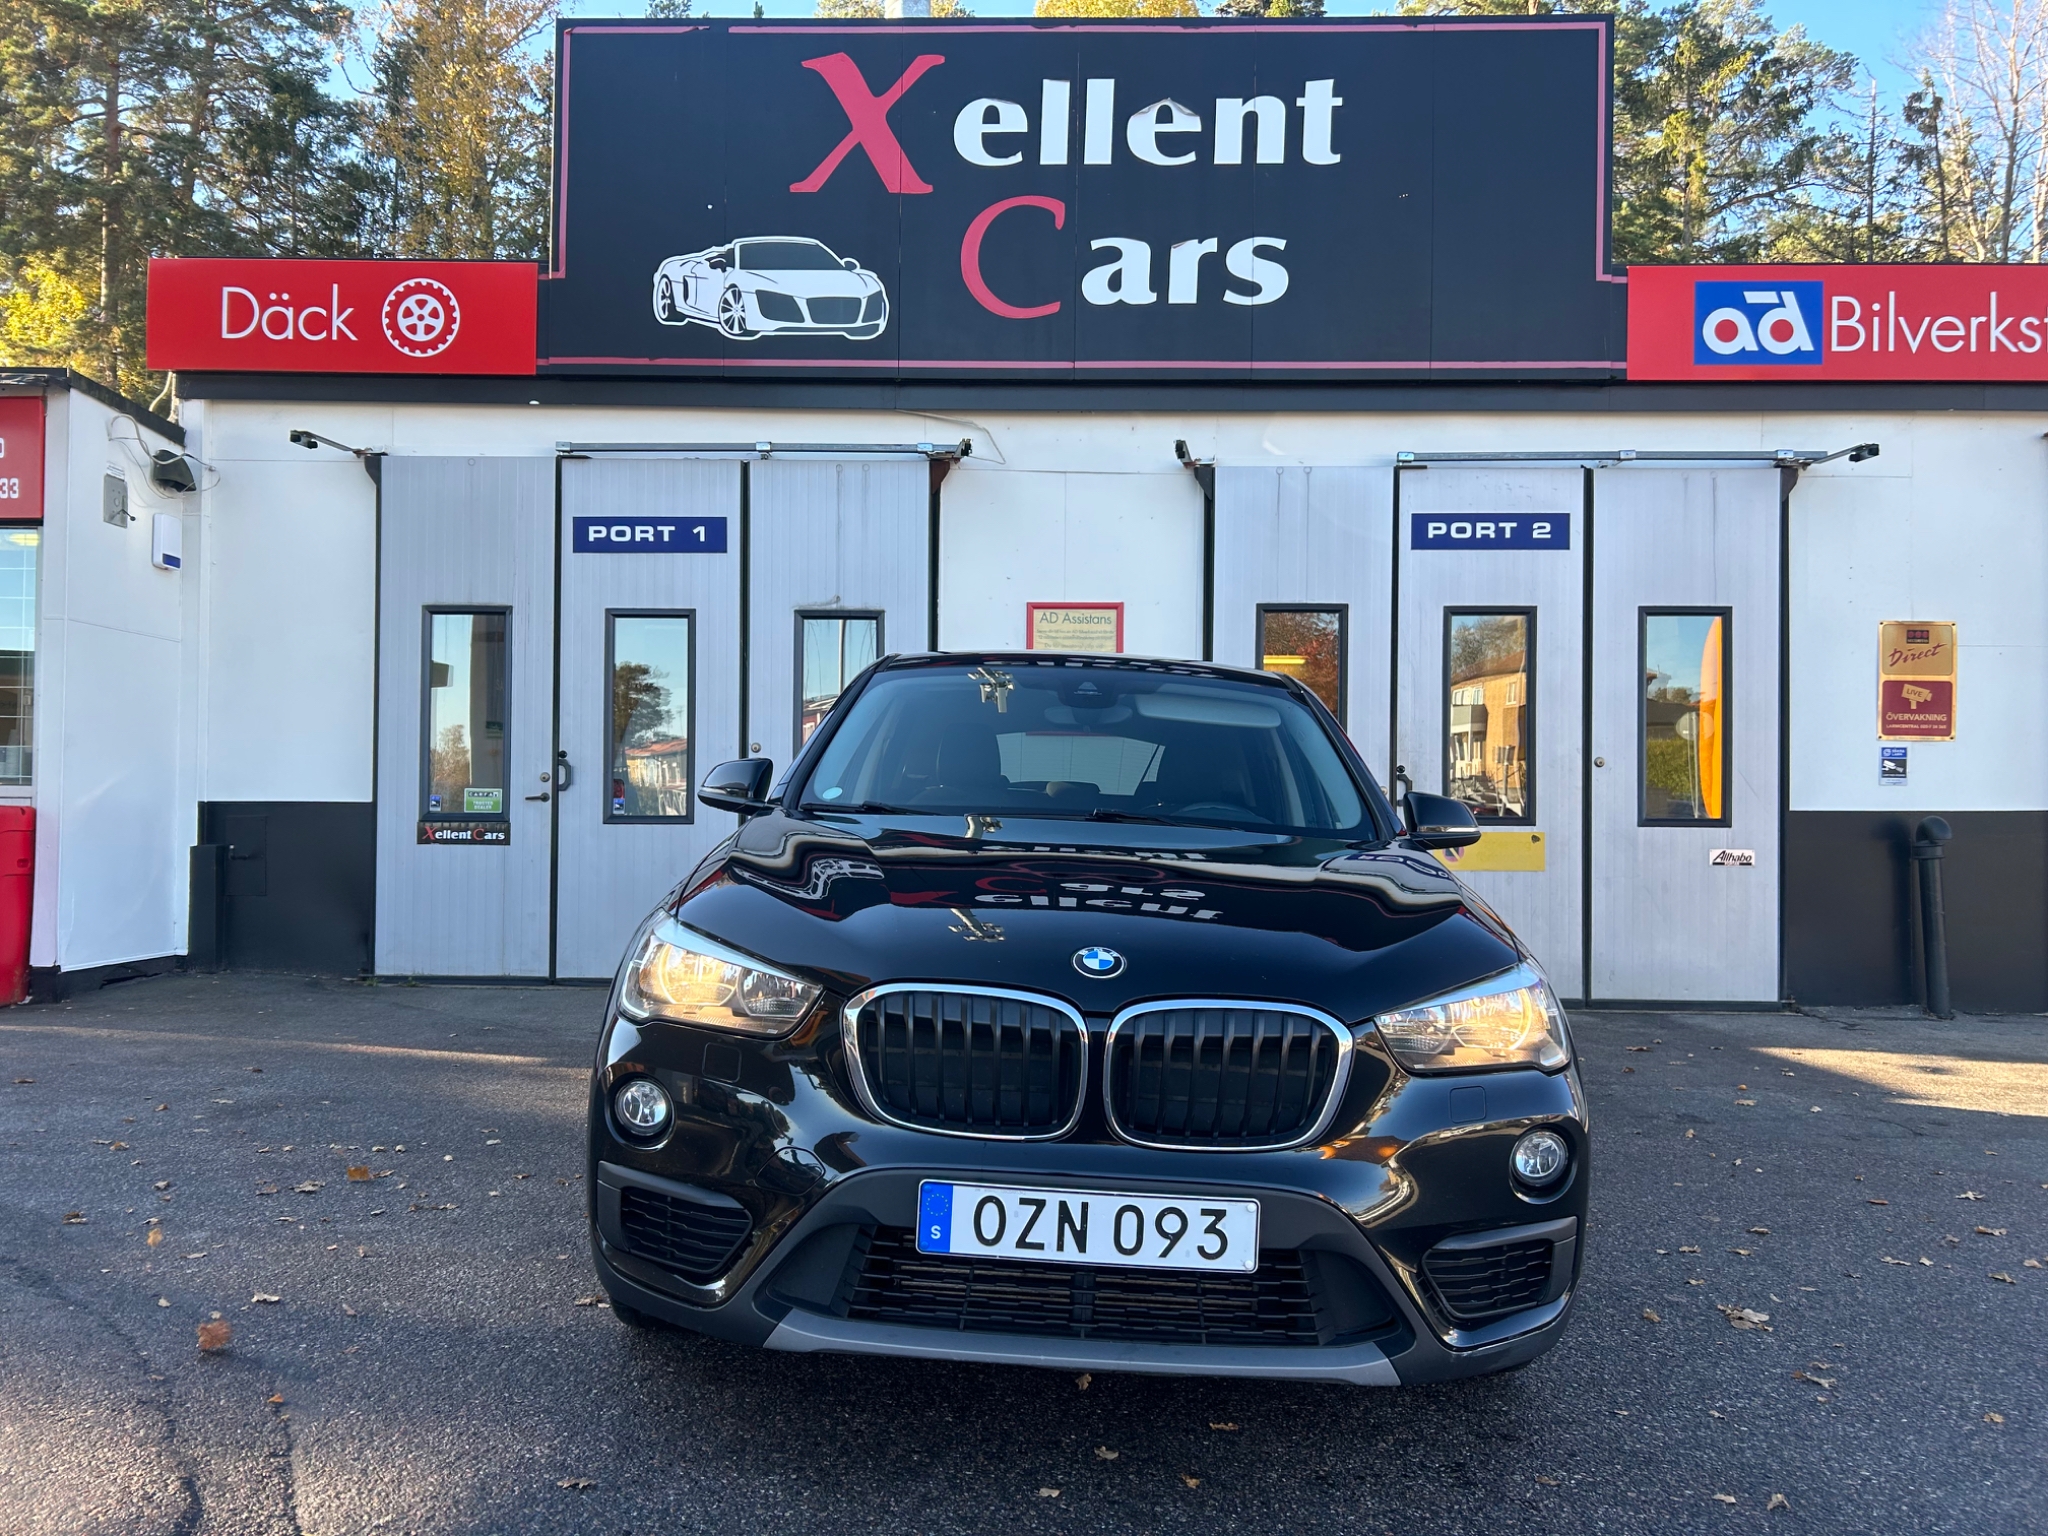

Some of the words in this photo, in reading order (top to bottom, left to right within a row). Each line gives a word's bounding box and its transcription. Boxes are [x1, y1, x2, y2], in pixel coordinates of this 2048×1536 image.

[789, 52, 1343, 194] Xellent
[961, 195, 1290, 319] Cars
[221, 283, 359, 341] Däck
[1831, 291, 2048, 355] Bilverks
[588, 525, 676, 542] PORT
[692, 525, 706, 542] 1
[1427, 522, 1518, 539] PORT
[1532, 522, 1552, 539] 2
[1039, 611, 1059, 624] AD
[1061, 611, 1112, 625] Assistans
[1888, 643, 1948, 668] Direct
[1906, 688, 1924, 698] LIVE
[1886, 712, 1948, 722] ÖVERVAKNING
[422, 826, 472, 840] Xellent
[472, 828, 505, 841] Cars
[1713, 850, 1752, 862] Allhabo
[930, 1225, 941, 1240] S
[973, 1195, 1090, 1255] OZN
[1113, 1204, 1230, 1261] 093
